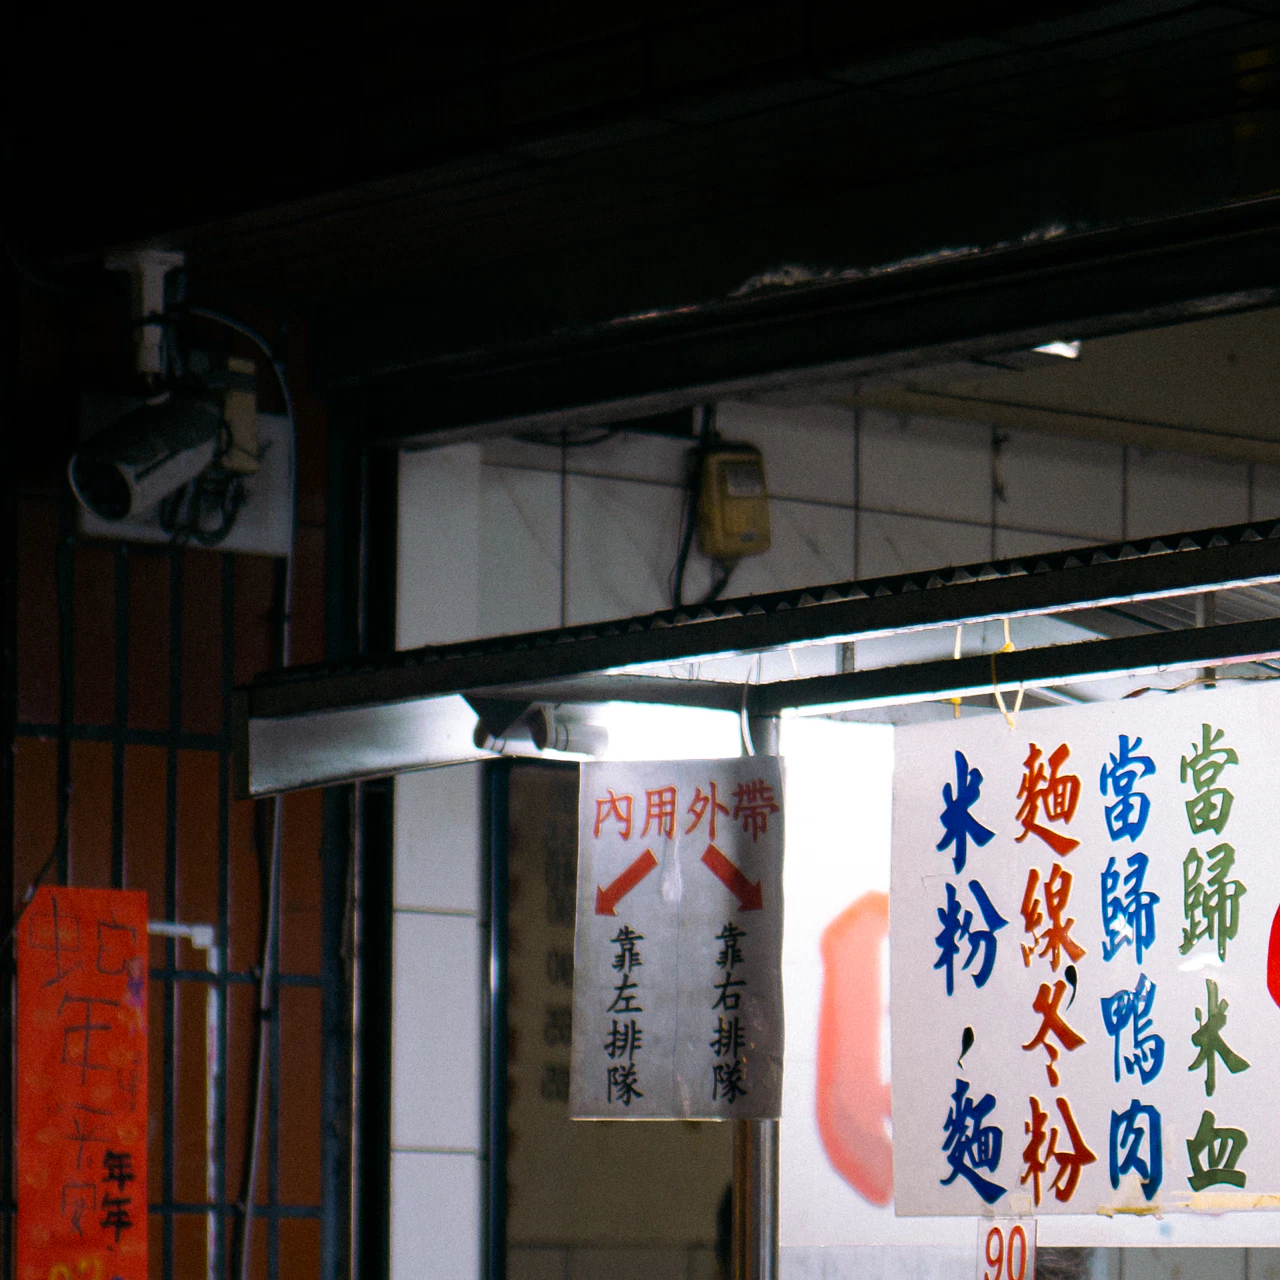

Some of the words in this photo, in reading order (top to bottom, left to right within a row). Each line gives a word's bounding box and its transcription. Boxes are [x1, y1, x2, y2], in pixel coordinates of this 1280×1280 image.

[593, 779, 780, 843] 內用外帶
[603, 924, 646, 1107] 靠左排隊
[709, 921, 749, 1105] 靠右排隊
[1099, 734, 1166, 1201] 當歸鴨肉
[1179, 723, 1251, 1192] 當歸米血
